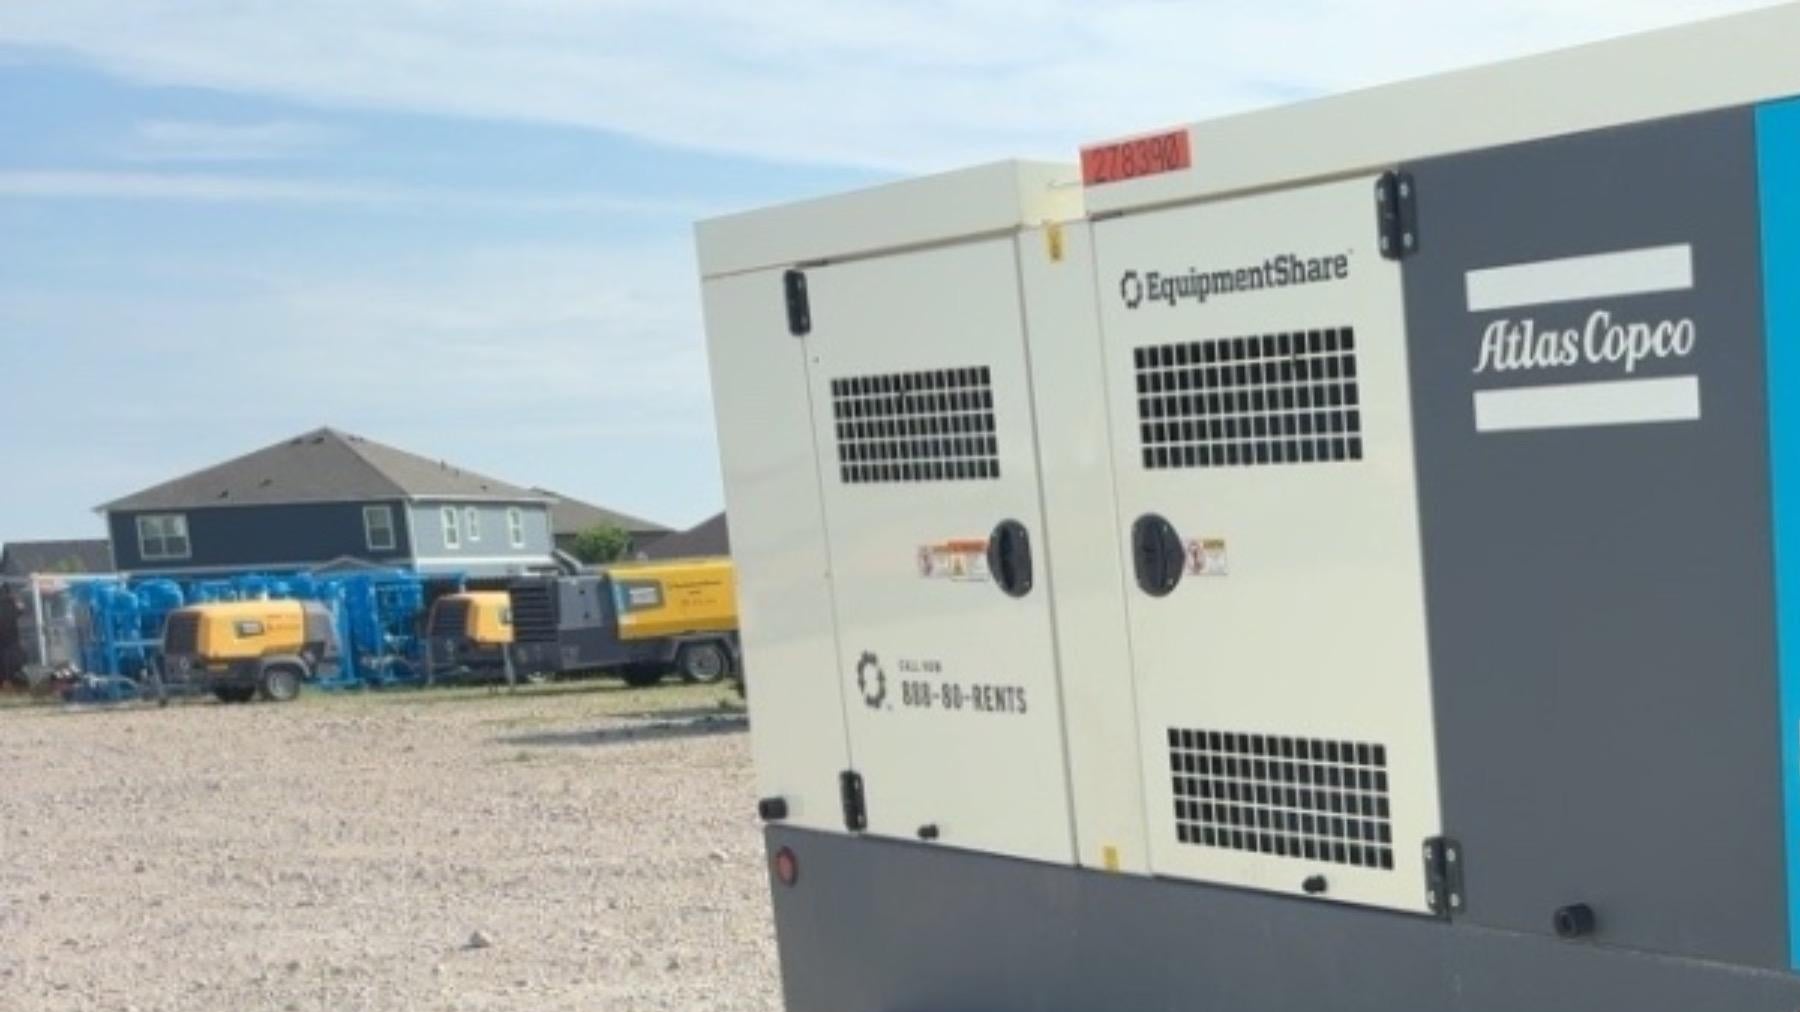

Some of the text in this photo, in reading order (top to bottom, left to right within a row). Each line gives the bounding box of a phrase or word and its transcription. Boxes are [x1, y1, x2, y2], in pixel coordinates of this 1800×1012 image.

[1145, 252, 1349, 307] EquipmentShare
[1472, 309, 1696, 374] Atlas Copco
[902, 680, 1028, 714] 888-80-RENTS
